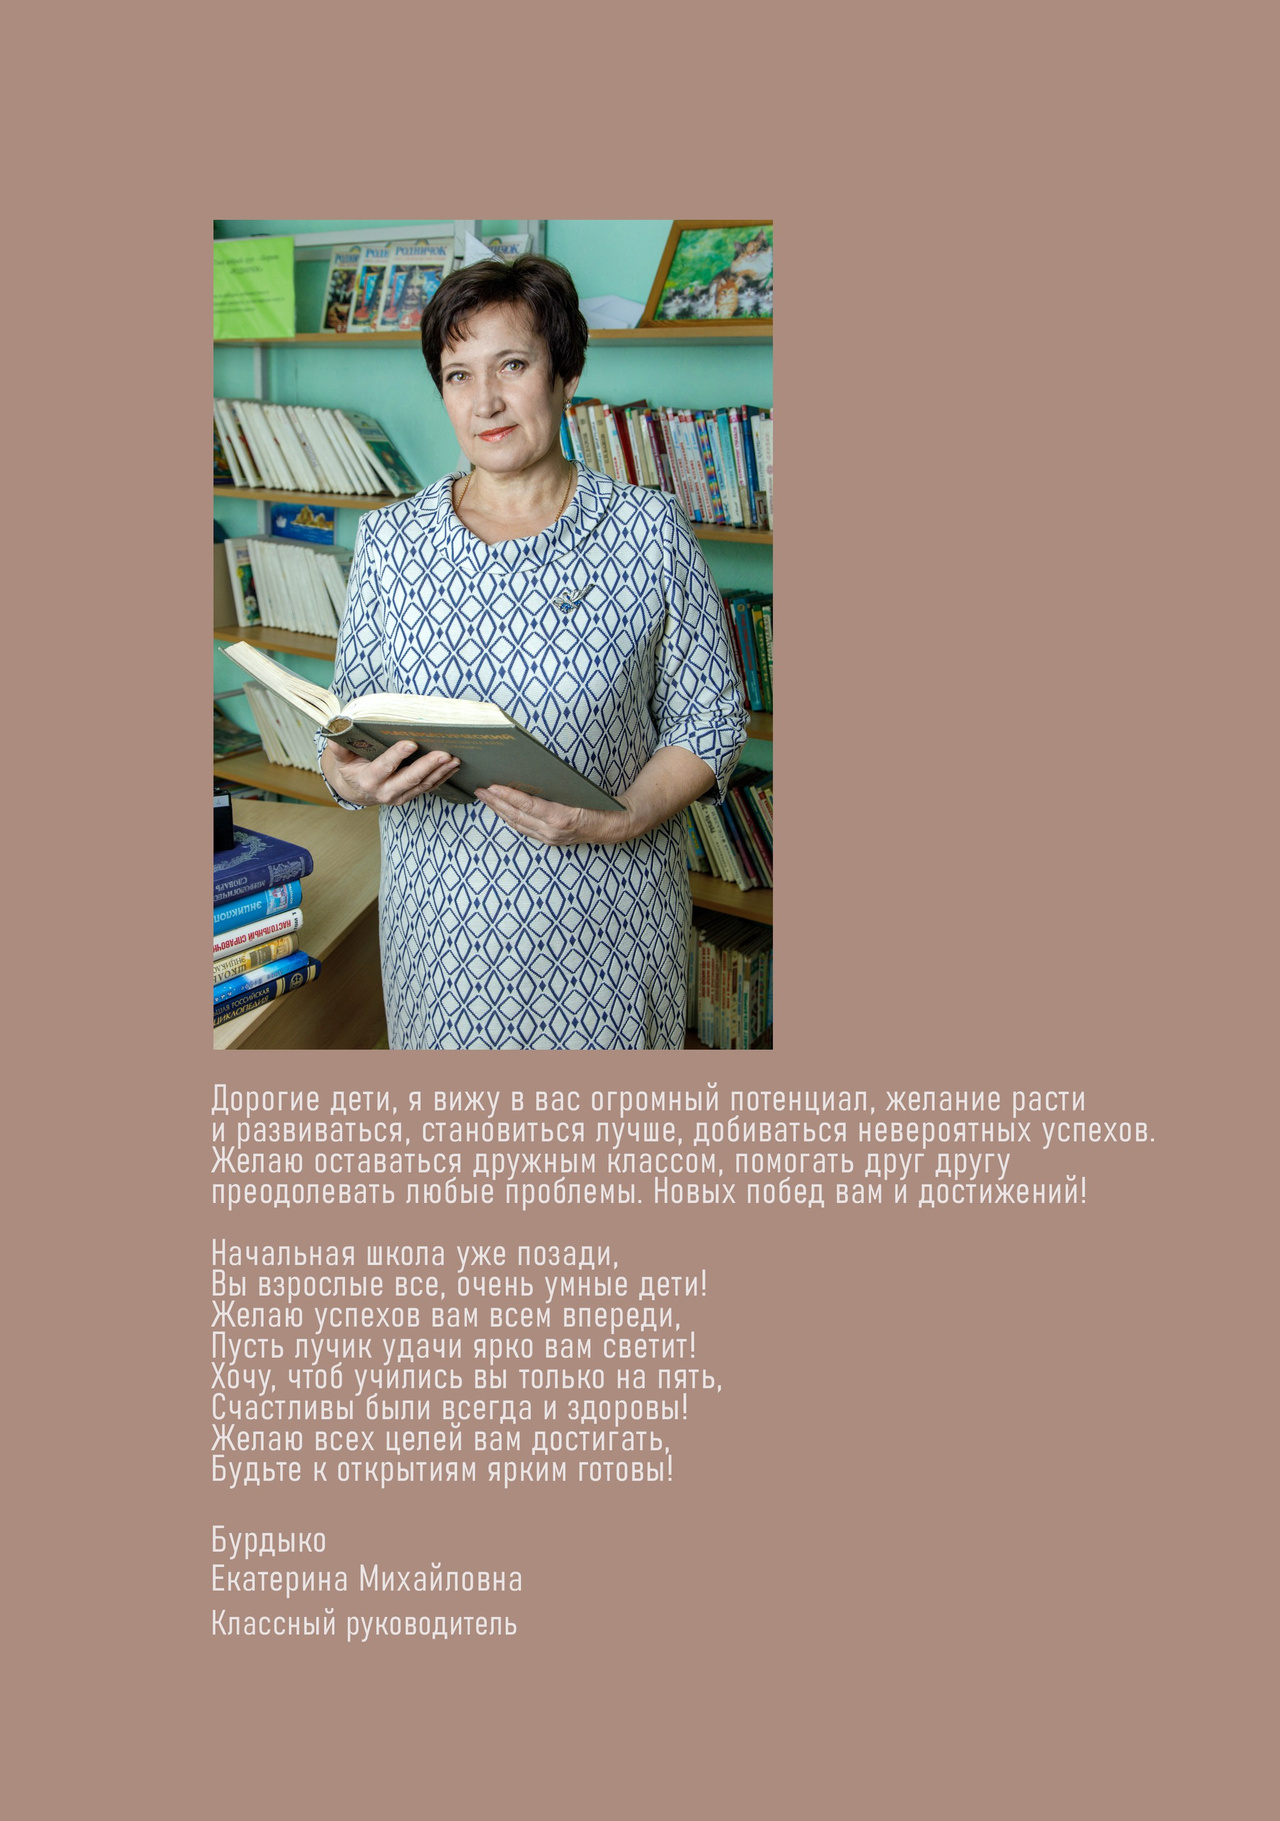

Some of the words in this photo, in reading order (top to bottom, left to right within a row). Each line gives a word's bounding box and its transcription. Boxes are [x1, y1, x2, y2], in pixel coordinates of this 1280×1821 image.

[213, 880, 266, 902] МИФОЛОГИЧЕС
[215, 876, 248, 891] СЛОВАРЬ
[213, 901, 262, 923] ЭНЦИКЛОП
[248, 919, 292, 940] НАСТОЛЬНЫЙ
[213, 934, 247, 953] СПРАВОЧН
[231, 987, 270, 1009] РОССИЙСКАЯ
[213, 994, 270, 1026] ЦИКЛОПЕДИЯ
